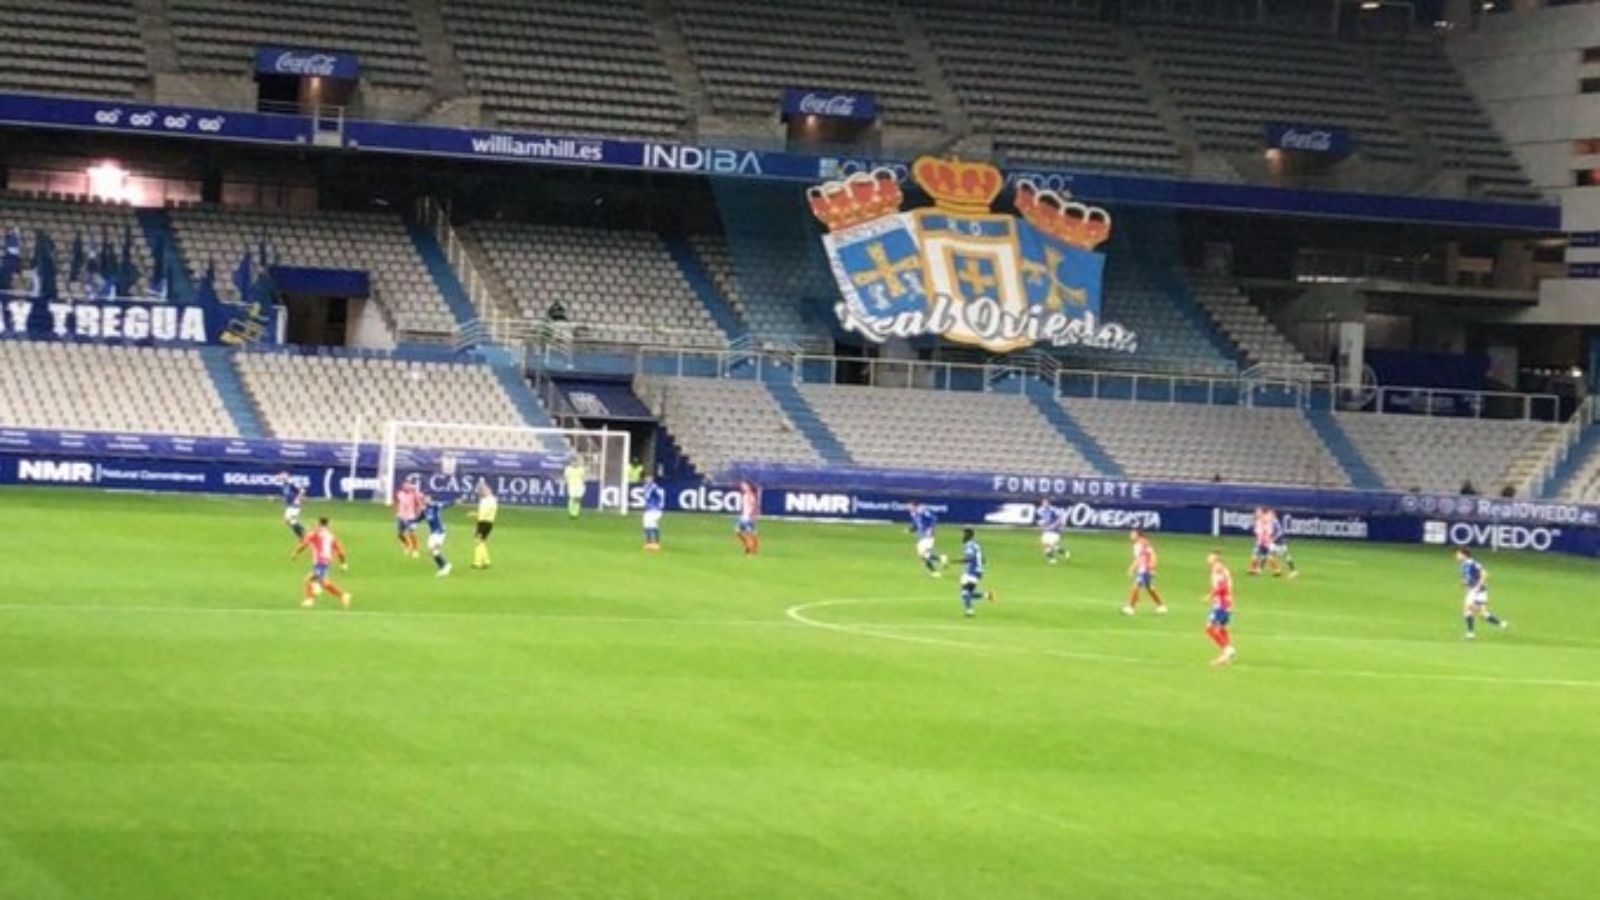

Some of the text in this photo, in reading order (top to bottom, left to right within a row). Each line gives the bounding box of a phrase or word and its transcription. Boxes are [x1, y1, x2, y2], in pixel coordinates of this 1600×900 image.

[472, 135, 603, 162] williamhill.es
[643, 143, 762, 175] INDIBA
[48, 303, 207, 343] TREGUA
[19, 460, 93, 483] NMR
[498, 478, 567, 496] LOBAT
[994, 476, 1142, 498] FONDO NORTE
[785, 492, 851, 514] NMR
[1450, 522, 1552, 550] OVIEDO
